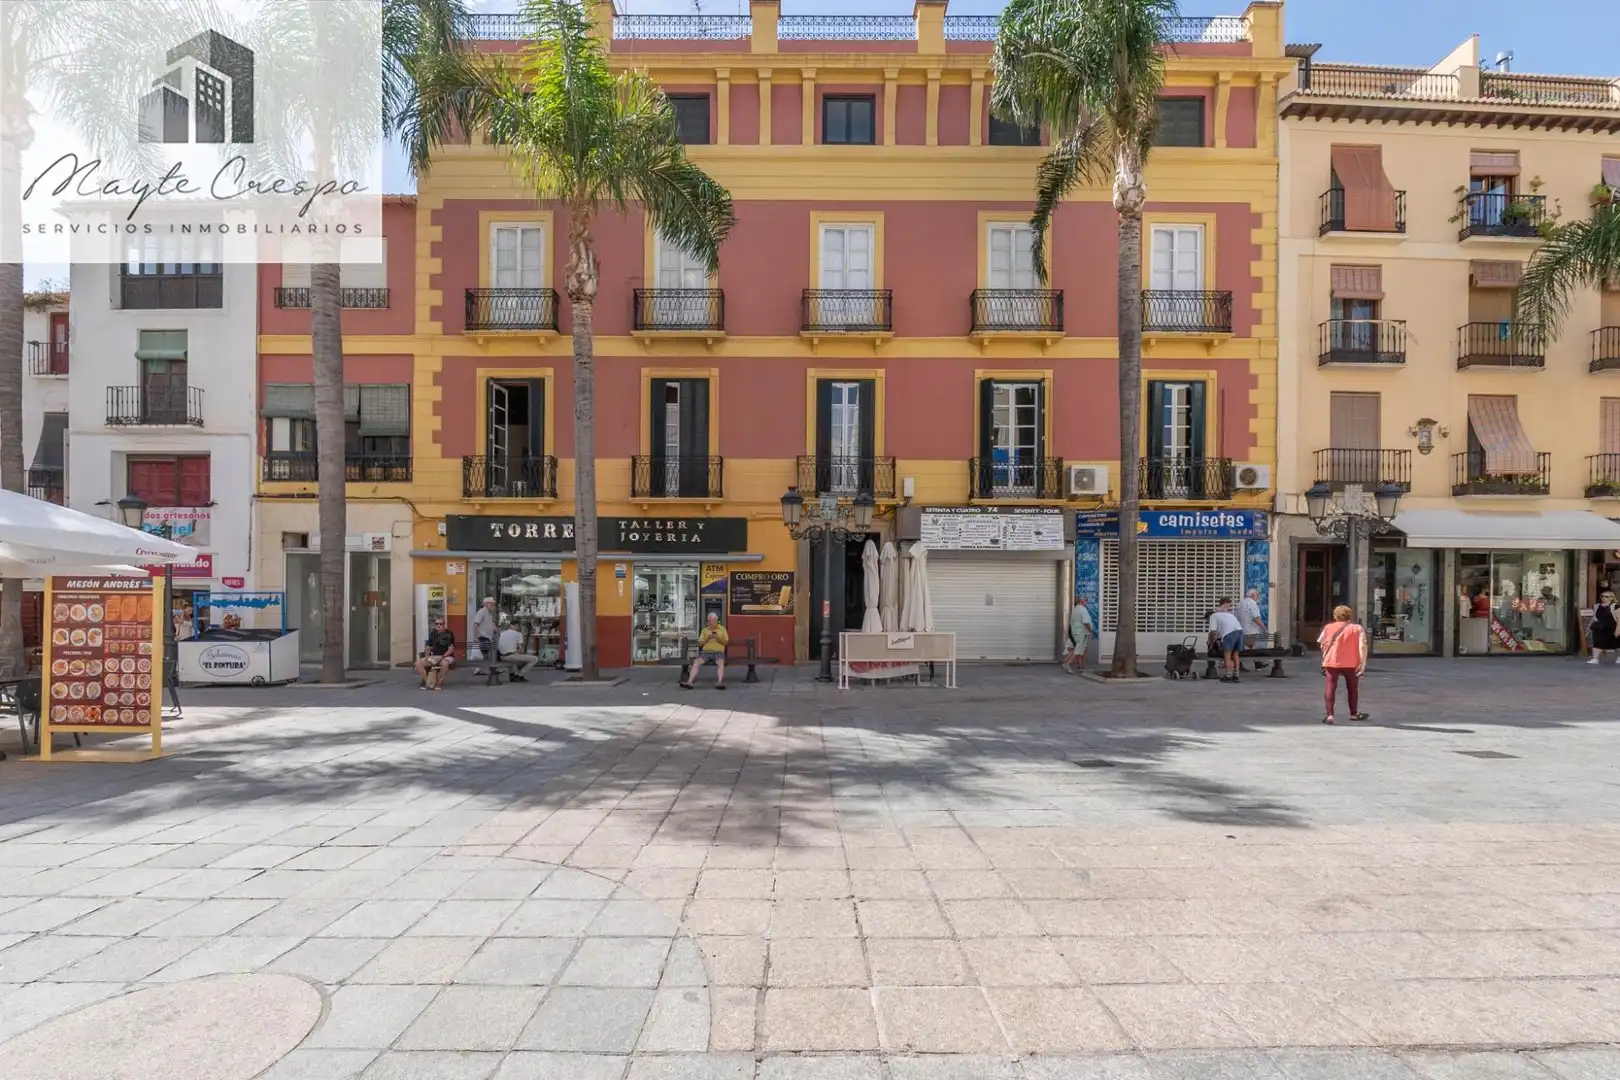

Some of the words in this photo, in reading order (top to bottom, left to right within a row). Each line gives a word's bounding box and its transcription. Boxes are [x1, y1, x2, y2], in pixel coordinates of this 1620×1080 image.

[618, 520, 688, 530] TALLER
[697, 522, 705, 530] Y
[1159, 512, 1245, 528] camisetas
[620, 532, 701, 543] JOYERIA
[735, 573, 771, 581] COMPRO
[771, 573, 789, 581] ORO
[66, 579, 100, 589] MESÓN
[103, 579, 141, 589] ANDRÉS
